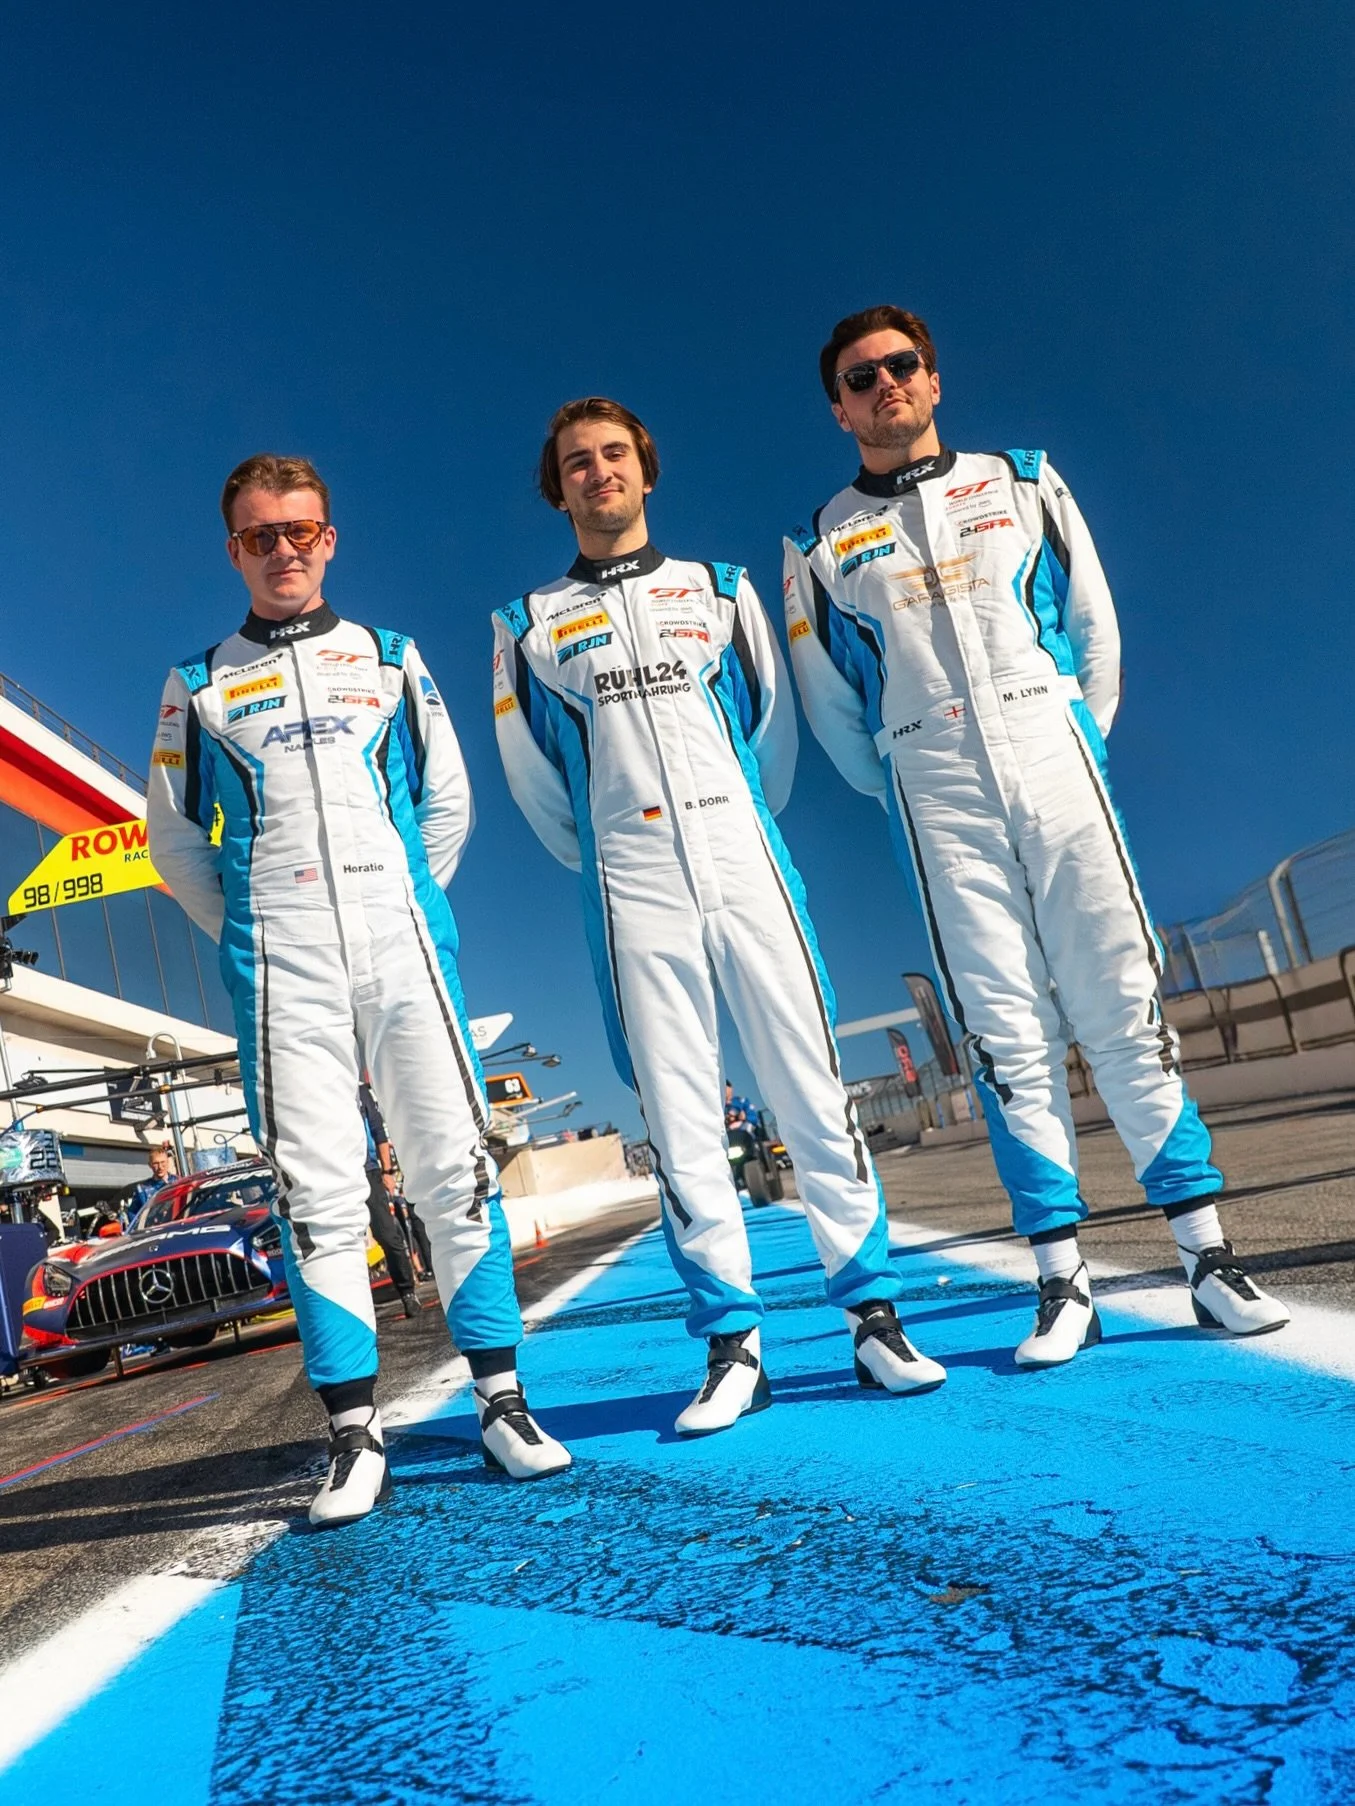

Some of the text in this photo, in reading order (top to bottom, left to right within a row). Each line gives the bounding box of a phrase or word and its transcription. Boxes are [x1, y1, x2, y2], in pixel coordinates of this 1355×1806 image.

[897, 460, 935, 485] HRX
[829, 505, 888, 535] McLaren
[861, 546, 890, 562] RJN
[602, 560, 640, 579] HRX
[893, 578, 990, 611] GARAGISTA
[547, 593, 607, 620] McLaren
[270, 621, 310, 639] HRX
[557, 615, 603, 639] PIRELLI
[578, 635, 607, 652] RJN
[219, 653, 283, 680] McLaren
[594, 660, 687, 694] RÜHL24
[229, 677, 278, 699] PIRELLI
[598, 683, 691, 707] SPORTNAHRUNG
[1003, 685, 1049, 702] M. LYNN
[249, 698, 281, 714] RJN
[261, 715, 357, 749] APEX
[893, 719, 923, 739] HRX
[284, 736, 336, 753] NAPLES
[685, 796, 730, 811] B. DORR
[70, 823, 147, 861] ROW
[125, 849, 149, 862] RAC
[343, 862, 385, 873] Horatio
